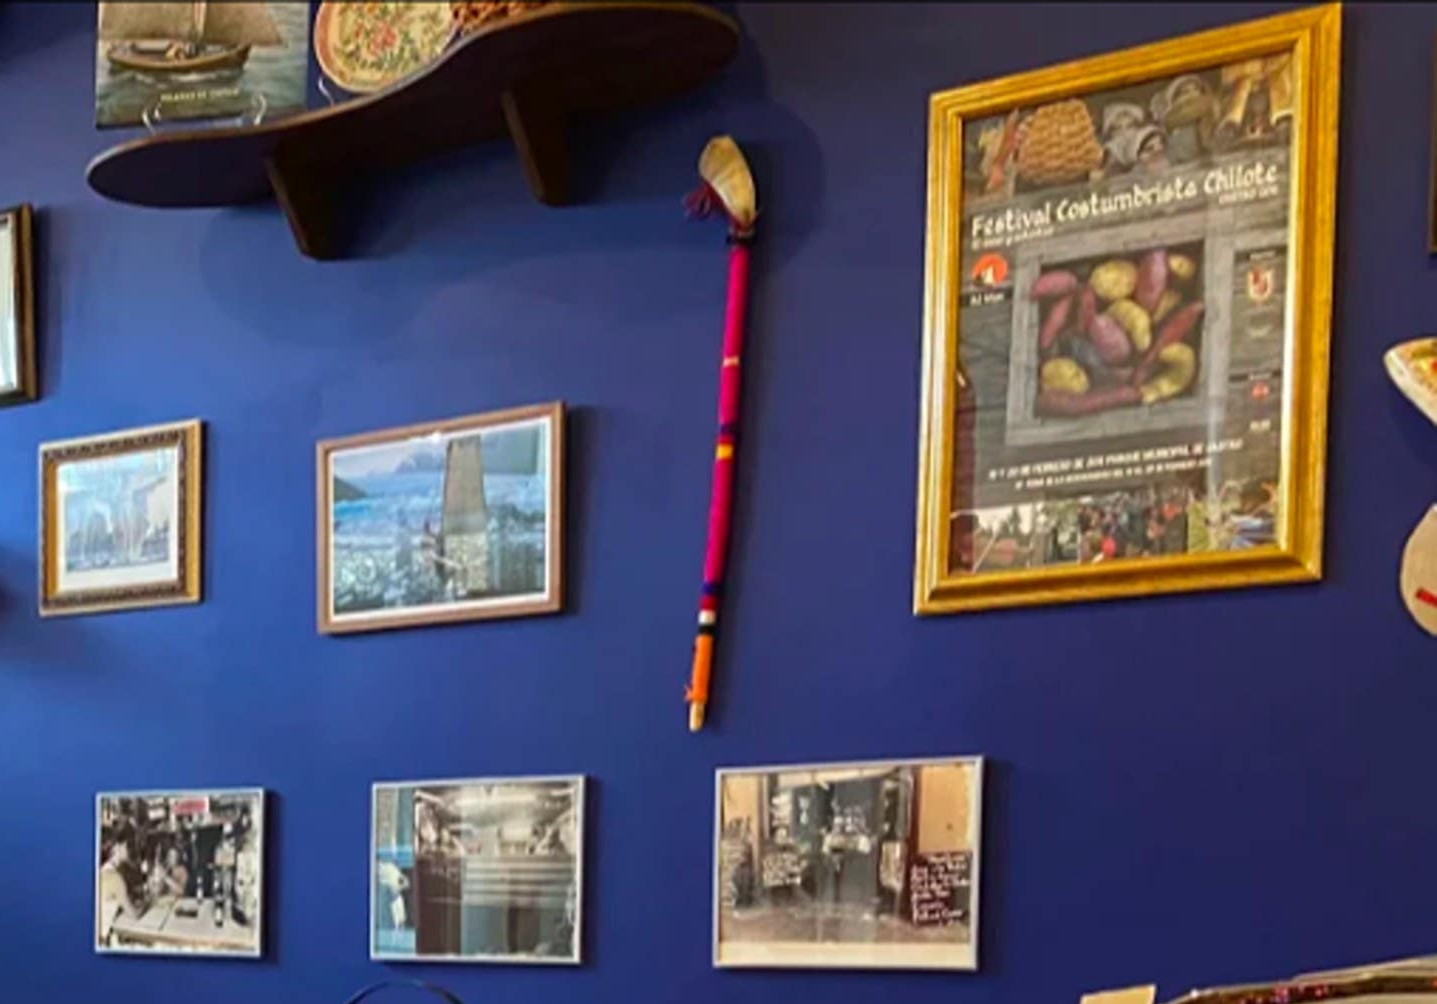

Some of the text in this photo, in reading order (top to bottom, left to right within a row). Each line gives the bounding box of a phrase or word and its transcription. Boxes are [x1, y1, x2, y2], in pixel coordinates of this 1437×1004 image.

[971, 201, 1051, 238] Festival
[1056, 178, 1197, 223] Costumbrista
[1204, 161, 1277, 194] Chilote
